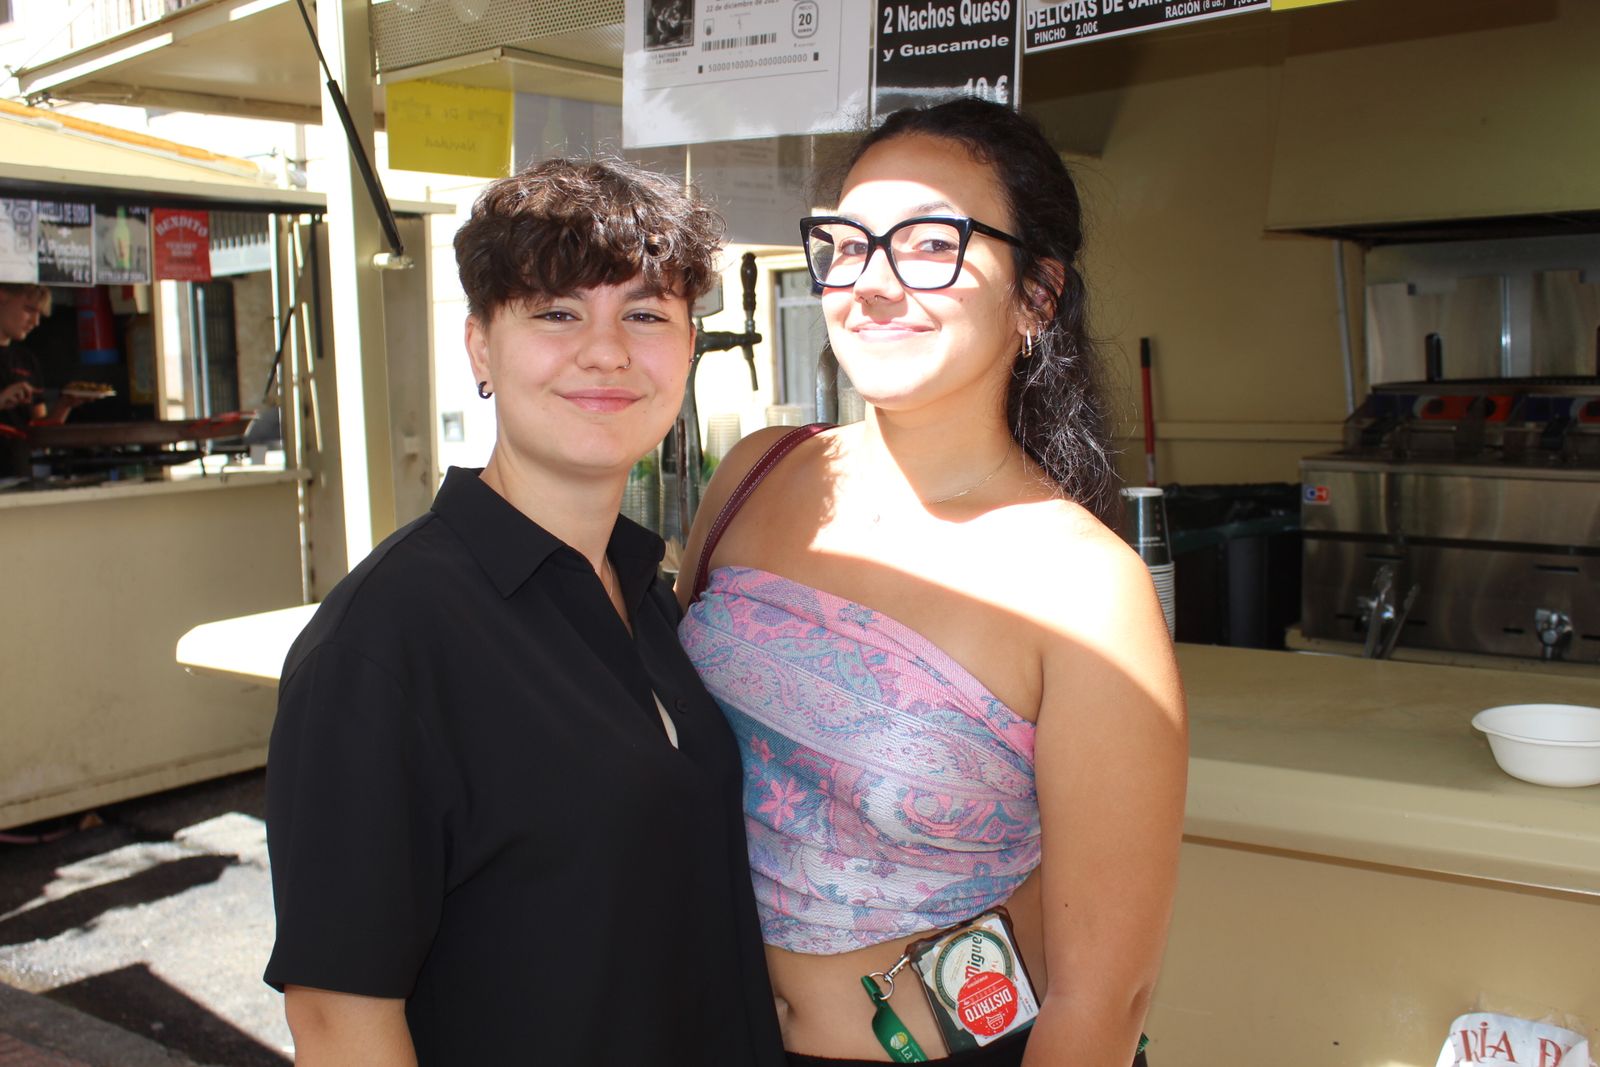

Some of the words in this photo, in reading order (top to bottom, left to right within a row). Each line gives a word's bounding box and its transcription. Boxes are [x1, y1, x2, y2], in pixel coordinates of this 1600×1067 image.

[705, 5, 714, 13] 22
[723, 0, 753, 10] diciembre
[798, 13, 812, 27] 20
[883, 7, 893, 34] 2
[897, 2, 955, 32] Nachos
[960, 0, 1010, 26] Queso
[1026, 0, 1097, 31] DELICIAS
[1103, 0, 1124, 15] DE
[1034, 27, 1066, 44] PINCHO
[1075, 21, 1098, 38] 2,00€
[1165, 0, 1200, 18] RACIÓN
[883, 49, 894, 62] y
[900, 35, 1009, 57] Guacamole
[155, 215, 209, 237] BENDITO
[964, 987, 1012, 1023] DISTRITO
[901, 1046, 913, 1060] La
